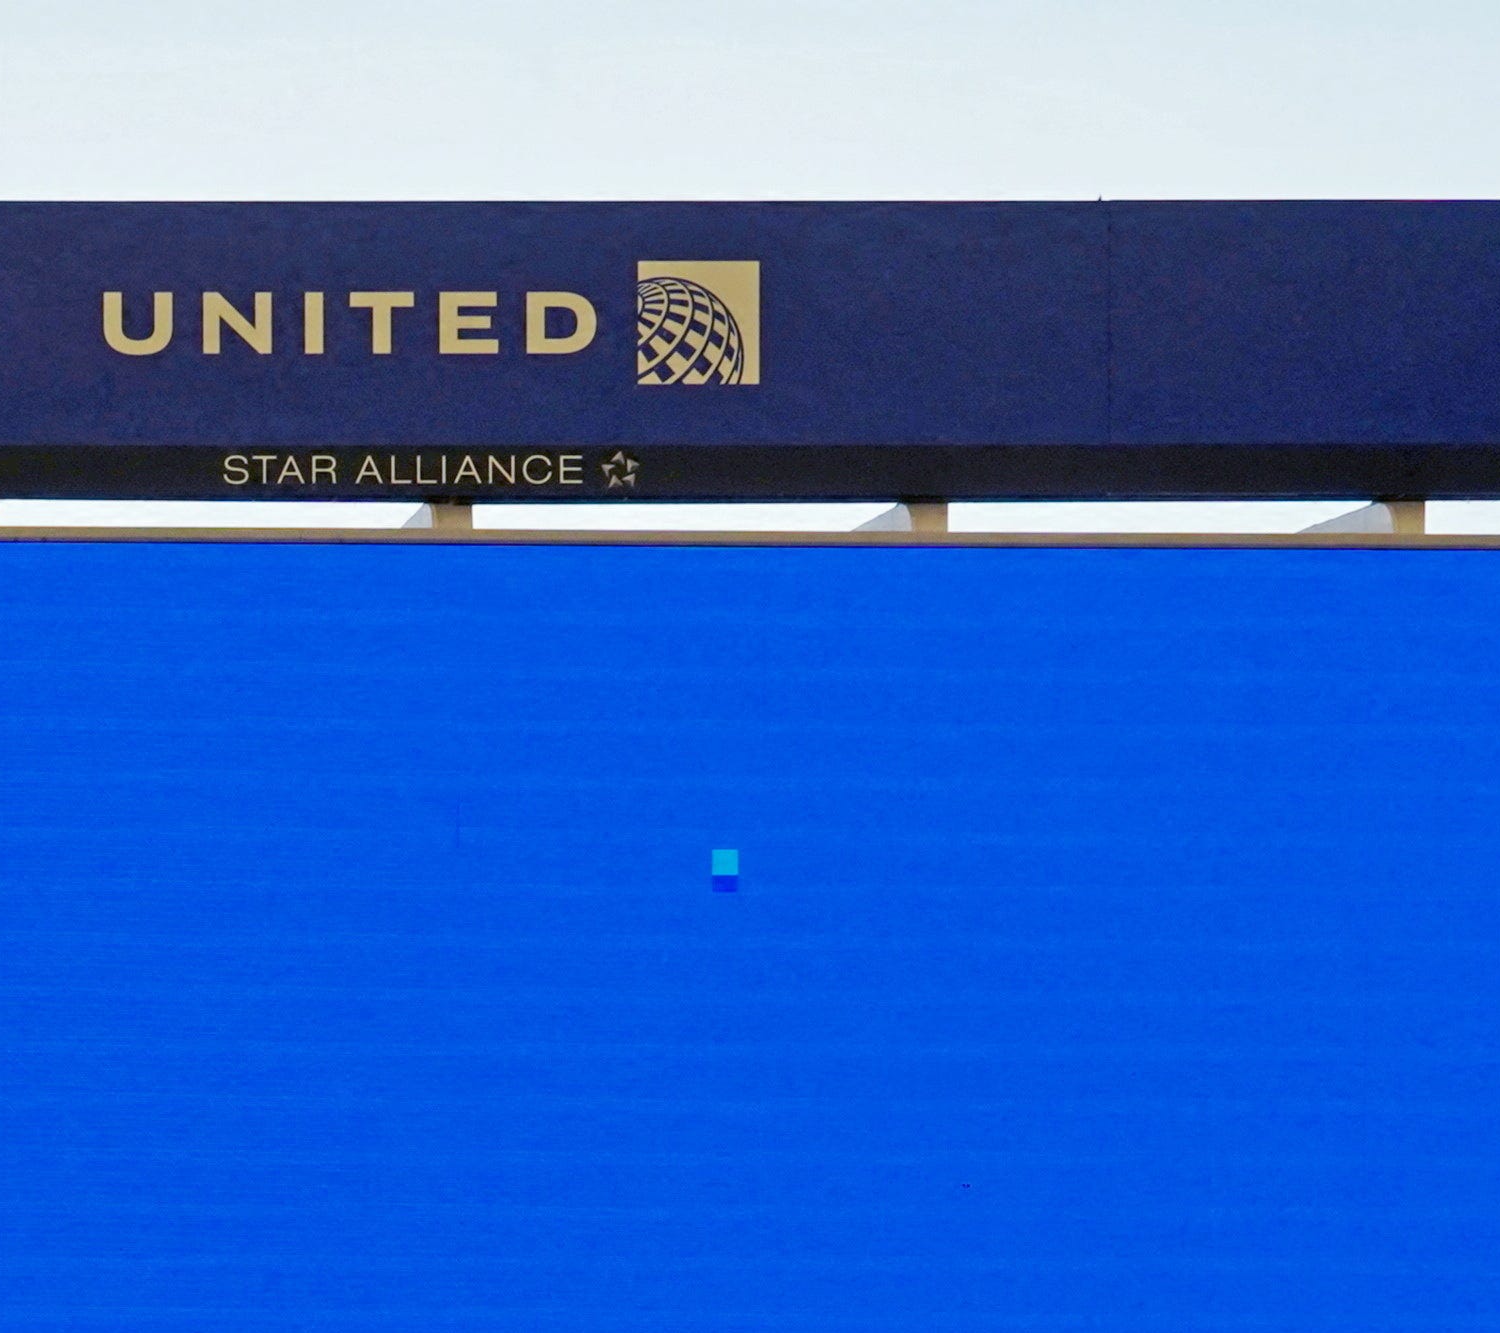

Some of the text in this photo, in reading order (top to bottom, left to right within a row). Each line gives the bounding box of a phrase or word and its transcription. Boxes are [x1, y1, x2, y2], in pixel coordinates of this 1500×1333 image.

[102, 290, 598, 356] UNITED
[222, 454, 584, 485] STAR ALLIANCE
